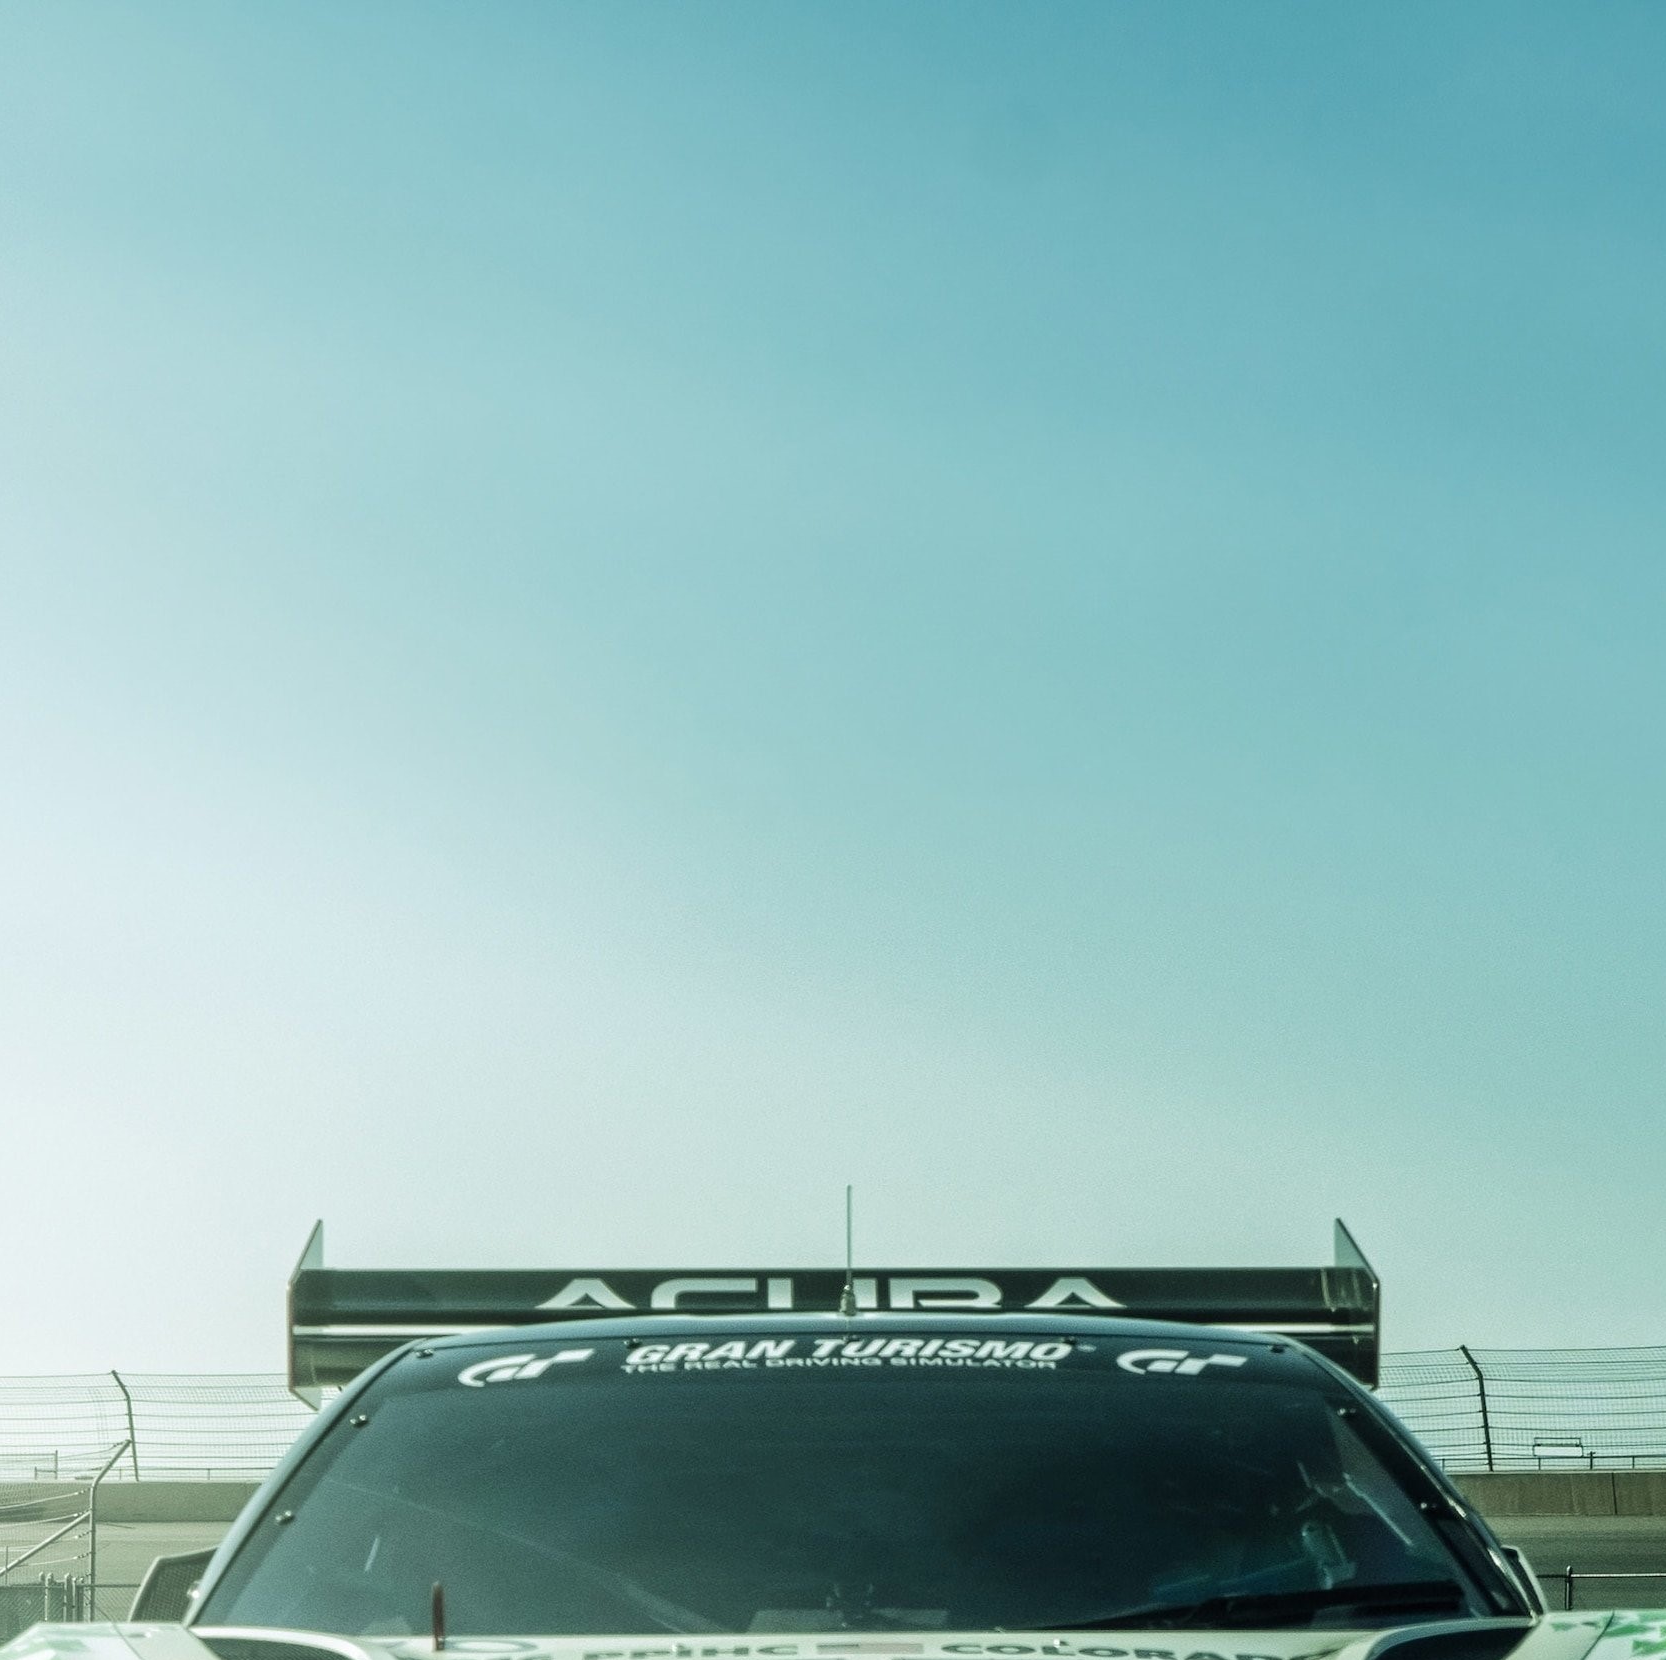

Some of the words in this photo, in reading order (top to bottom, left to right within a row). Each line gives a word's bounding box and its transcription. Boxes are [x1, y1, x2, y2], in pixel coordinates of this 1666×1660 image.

[625, 1340, 797, 1365] GRAN
[812, 1338, 1073, 1361] TURISMO
[620, 1361, 677, 1374] THE
[683, 1359, 758, 1371] REAL
[765, 1356, 883, 1369] DRIVING
[889, 1356, 1057, 1370] SIMULATOR
